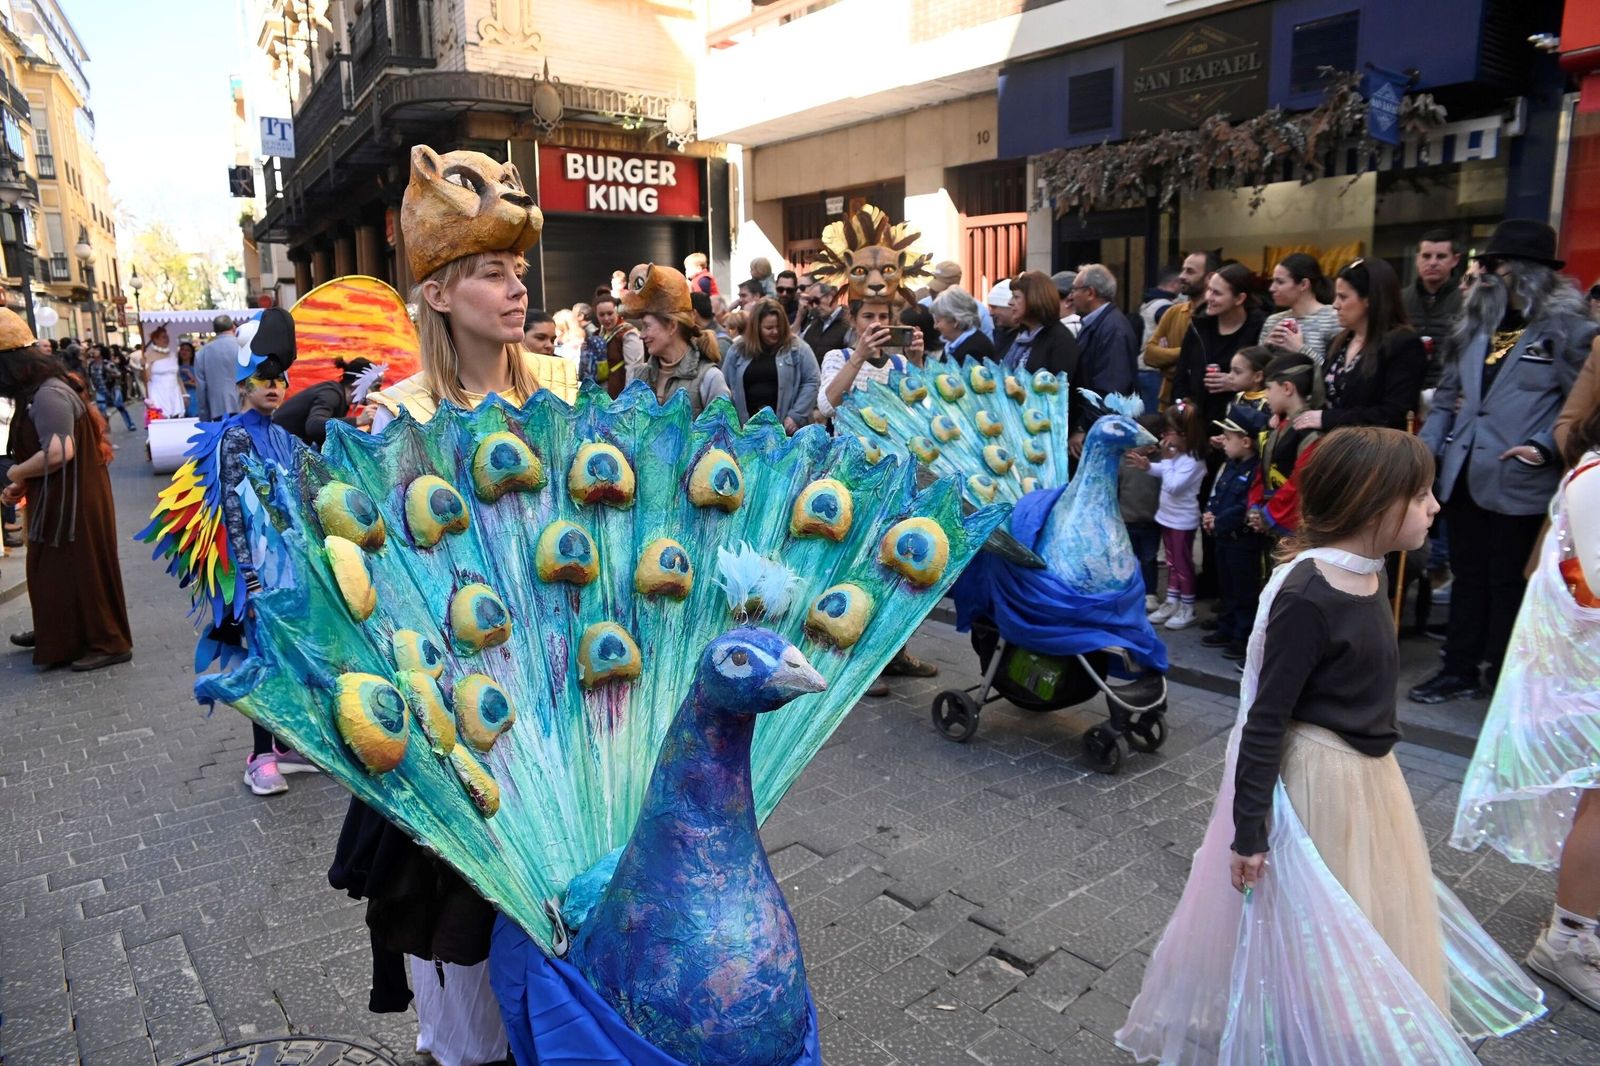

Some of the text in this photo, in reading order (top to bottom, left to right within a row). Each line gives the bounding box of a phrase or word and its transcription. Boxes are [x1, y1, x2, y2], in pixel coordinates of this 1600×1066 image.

[1133, 52, 1262, 93] SAN RAFAEL
[260, 117, 292, 141] TT
[977, 129, 990, 145] 10
[565, 152, 677, 187] BURGER
[588, 183, 659, 213] KING
